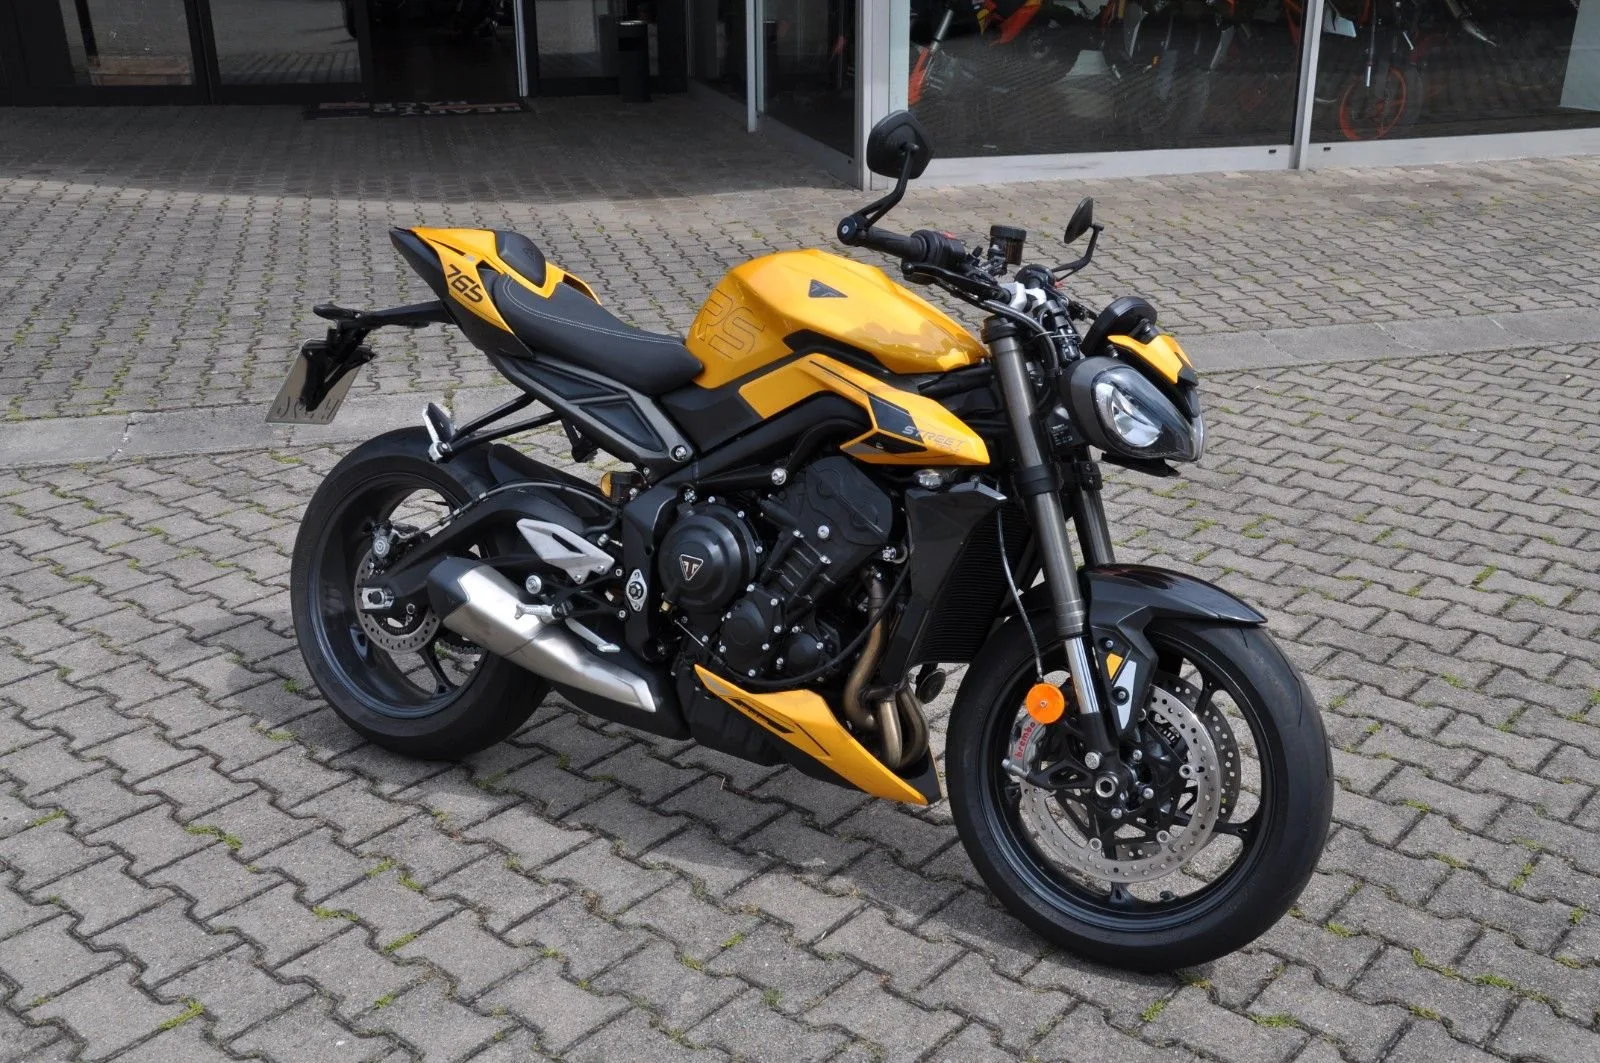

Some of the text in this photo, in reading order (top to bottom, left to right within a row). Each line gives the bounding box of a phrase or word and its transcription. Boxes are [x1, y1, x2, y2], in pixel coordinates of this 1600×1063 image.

[447, 264, 484, 302] 765
[901, 425, 967, 450] STREET
[1015, 722, 1036, 758] brembo
